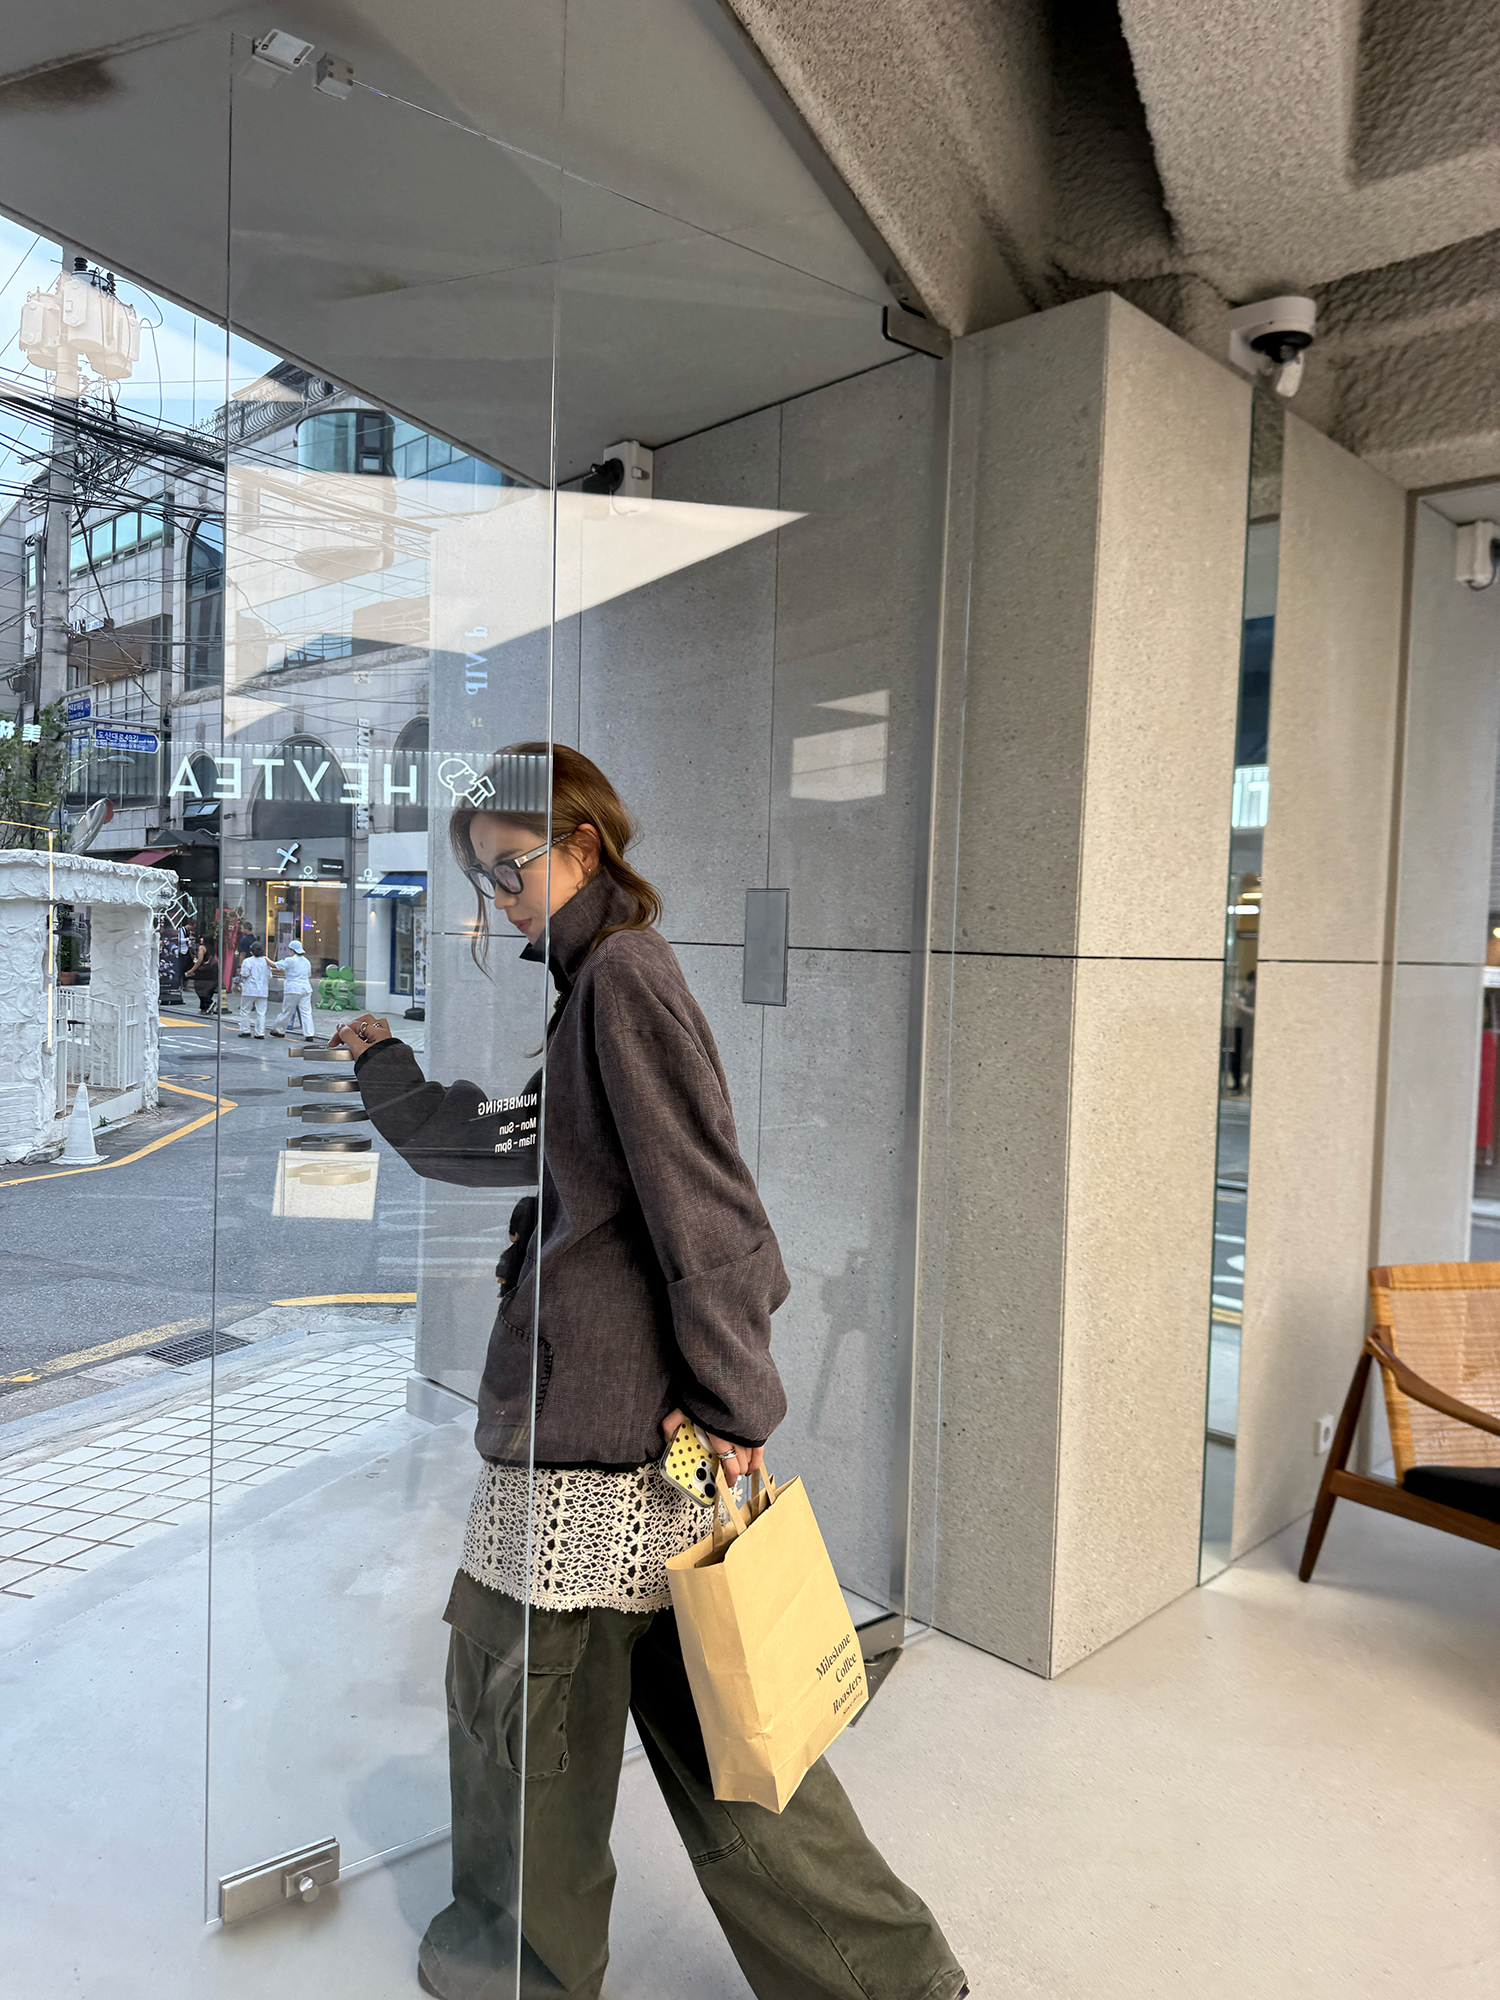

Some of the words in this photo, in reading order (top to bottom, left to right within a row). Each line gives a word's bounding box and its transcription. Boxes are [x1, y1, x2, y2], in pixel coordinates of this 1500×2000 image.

[97, 731, 139, 743] 도산대로49길
[815, 1633, 852, 1681] Milestone
[835, 1653, 858, 1683] Coffee
[832, 1672, 863, 1716] Roasters
